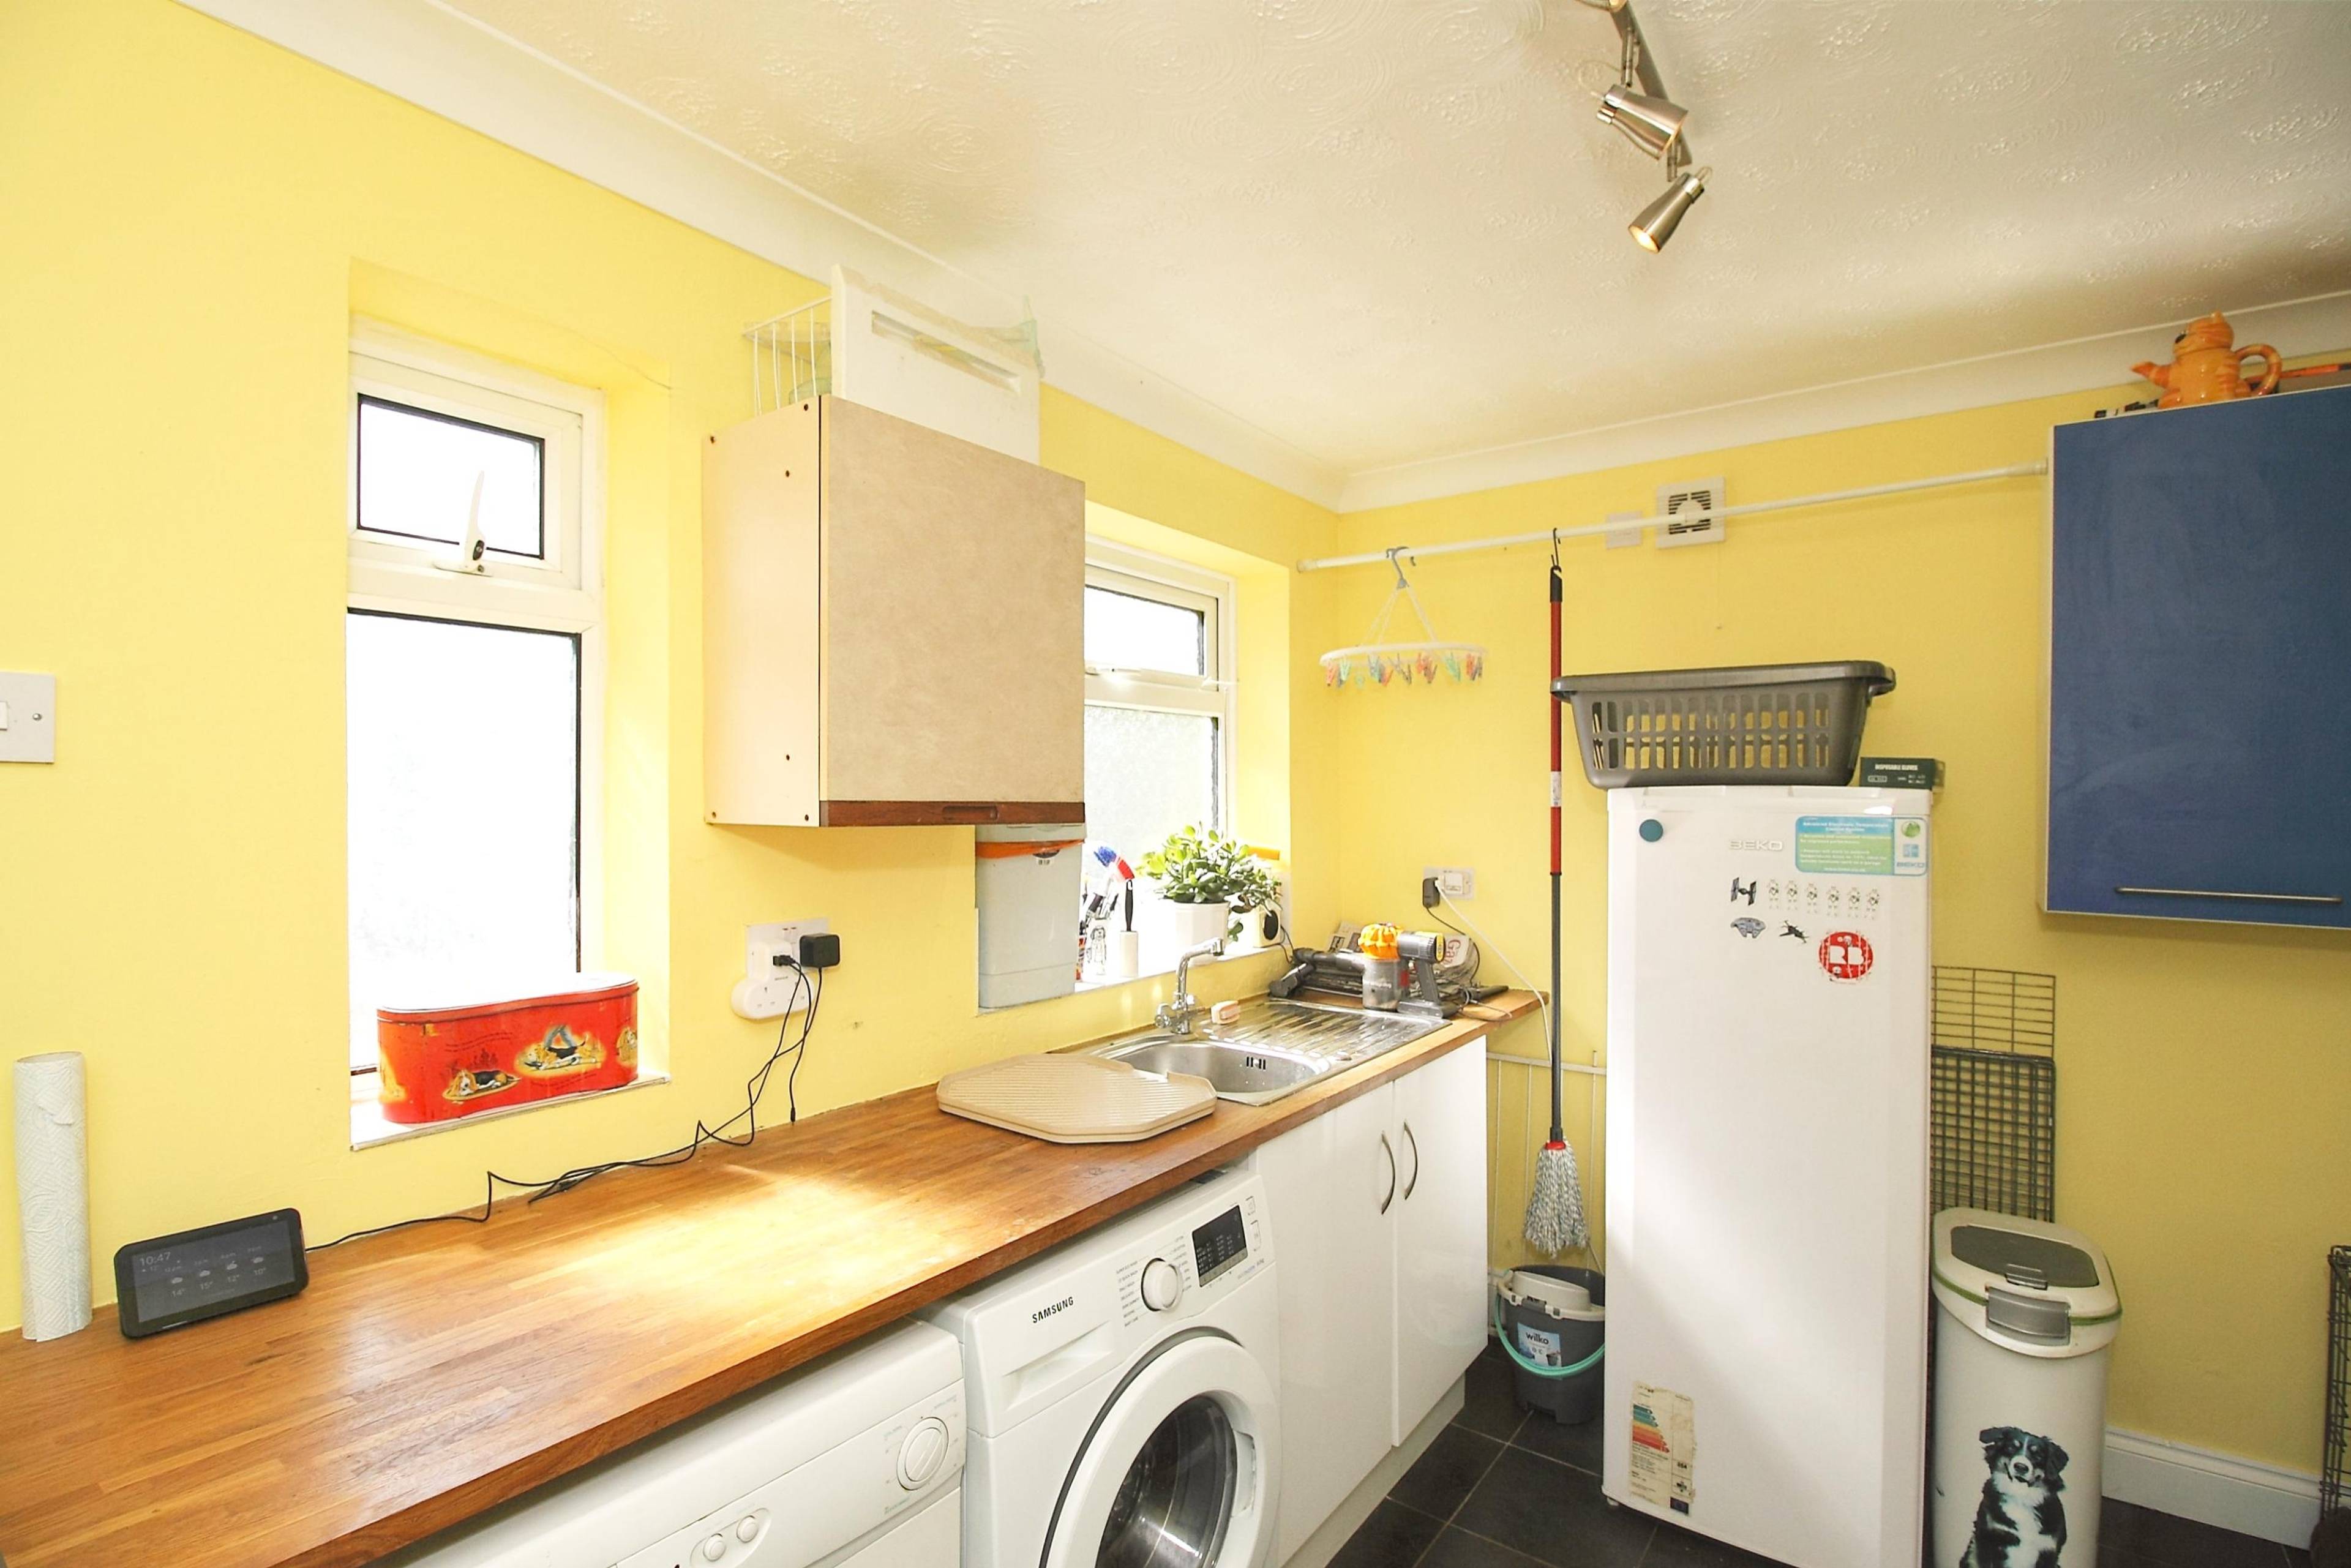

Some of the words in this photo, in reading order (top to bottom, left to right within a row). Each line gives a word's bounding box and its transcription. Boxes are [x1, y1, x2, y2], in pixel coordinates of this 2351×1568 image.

[1729, 840, 1782, 850] BEKO
[1032, 1296, 1073, 1323] SAMSUNG
[1526, 1332, 1549, 1345] wilko
